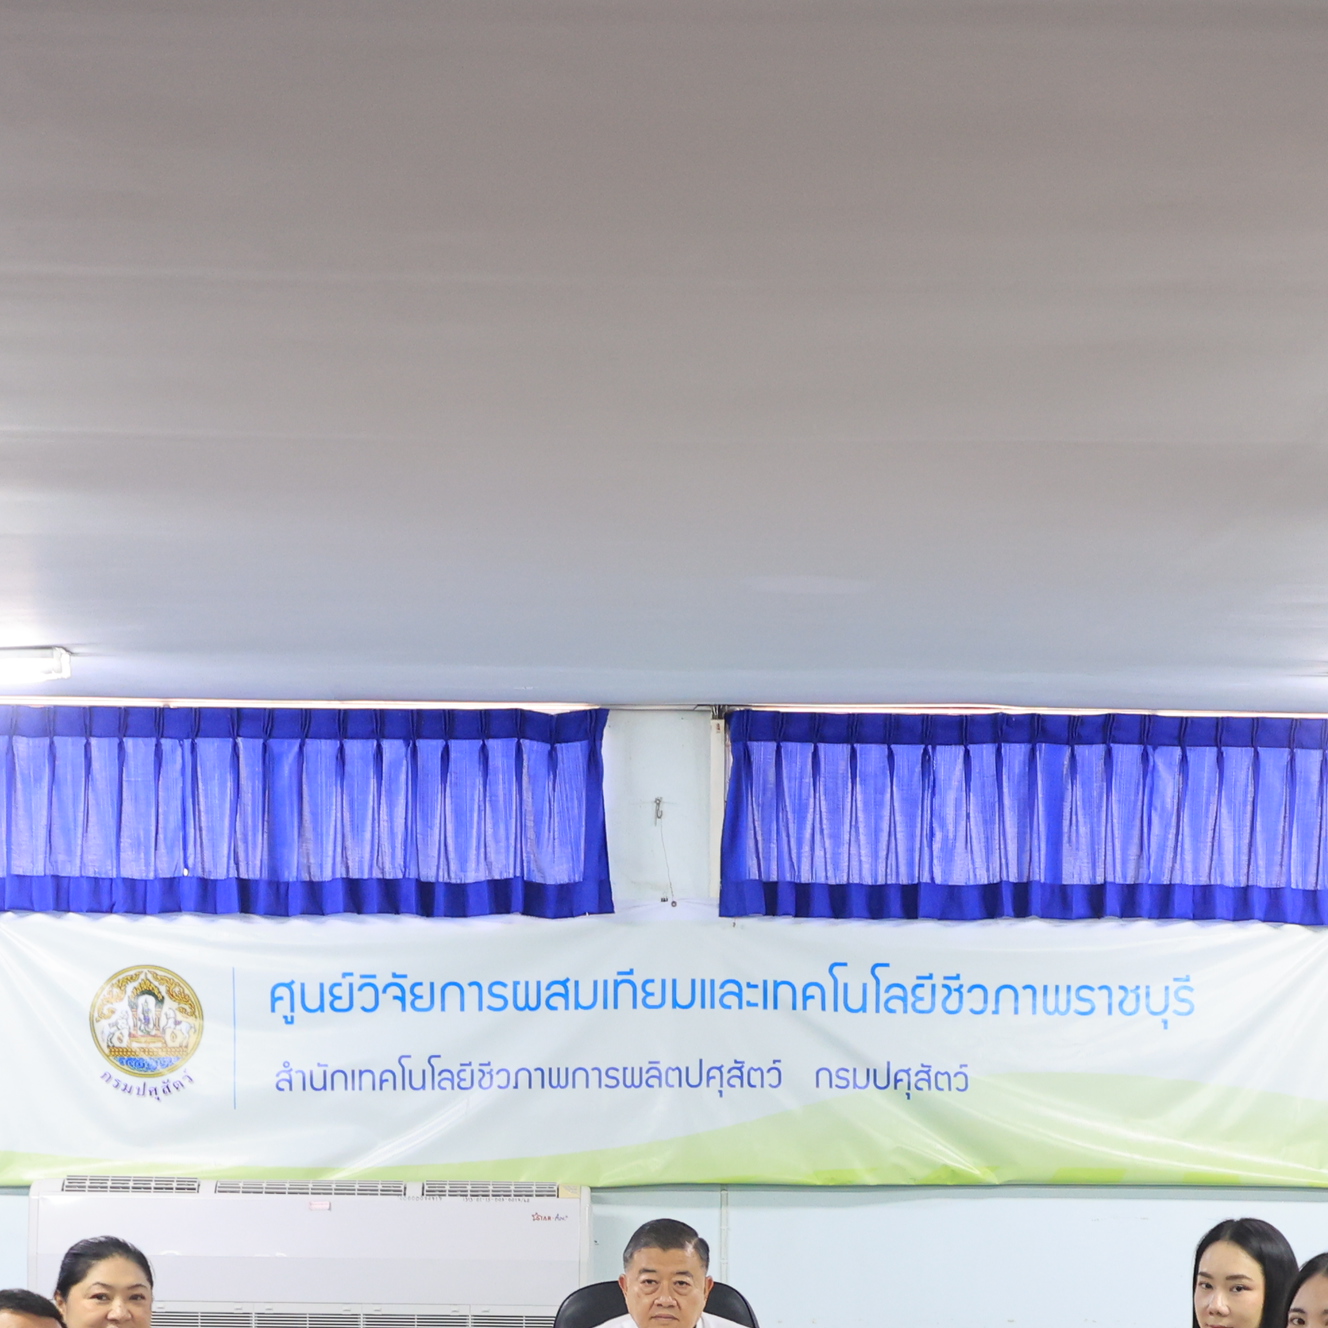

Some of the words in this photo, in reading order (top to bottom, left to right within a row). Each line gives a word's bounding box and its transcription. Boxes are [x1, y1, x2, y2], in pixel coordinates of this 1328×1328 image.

[269, 962, 1196, 1030] ศูนย์วิจัยการผสมเทียมและเทคโนโลยีชีวภาพราชบุรี
[99, 1068, 195, 1102] กรมปศุสัตว์
[274, 1054, 783, 1099] สำนักเทคโนโลยีชีวภาพการผลิตปศุสัตว์
[815, 1061, 970, 1100] กรมปศุสัตว์
